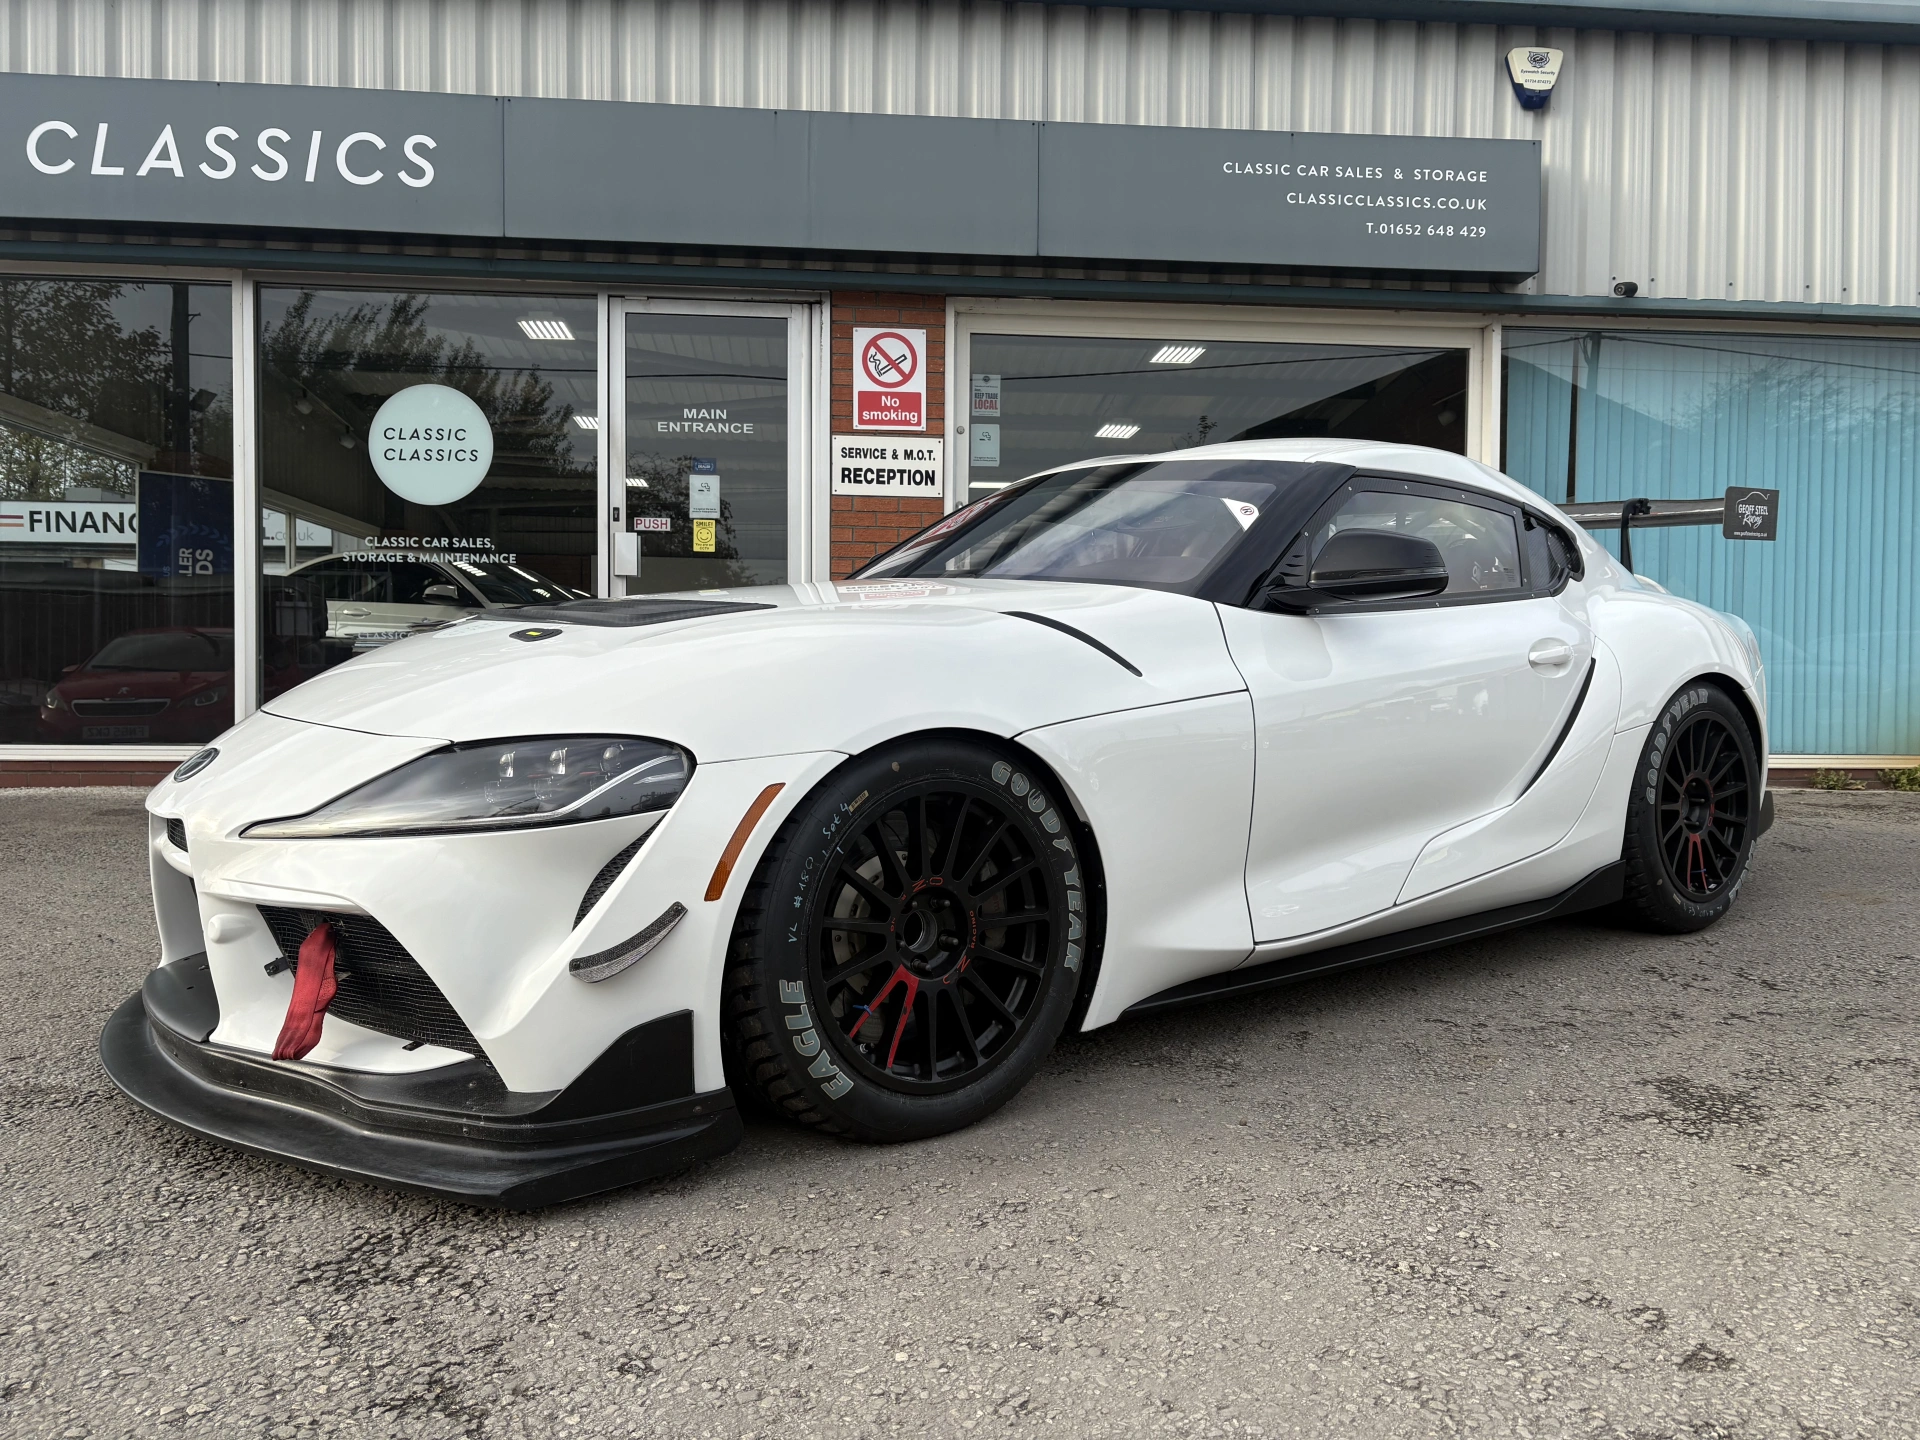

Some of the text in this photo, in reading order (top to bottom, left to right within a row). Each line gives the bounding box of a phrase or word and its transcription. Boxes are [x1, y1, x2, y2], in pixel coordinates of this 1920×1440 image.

[26, 120, 438, 188] CLASSICS
[1222, 161, 1488, 183] CLASSIC CAR SALES & STORAGE
[1286, 192, 1487, 211] CLASSICCLASSICS.CO.UK
[1365, 222, 1487, 238] T.01652 648 429
[880, 395, 901, 408] No
[974, 399, 998, 410] LOCAL
[682, 408, 728, 420] MAIN
[862, 409, 919, 424] smoking
[383, 427, 467, 442] CLASSIC
[656, 421, 755, 434] ENTRANCE
[383, 448, 479, 462] CLASSICS
[840, 446, 937, 462] SERVICE & M.O.T.
[840, 467, 936, 487] RECEPTION
[1738, 504, 1755, 514] GEOFF
[634, 517, 669, 531] PUSH
[364, 536, 495, 550] CLASSIC CAR SALES,
[179, 548, 193, 577] LER
[342, 551, 517, 564] STORAGE & MAINTENANCE
[1646, 688, 1709, 805] GOODYEAR
[991, 760, 1087, 973] GOODYEAR
[779, 978, 855, 1101] EAGLE
